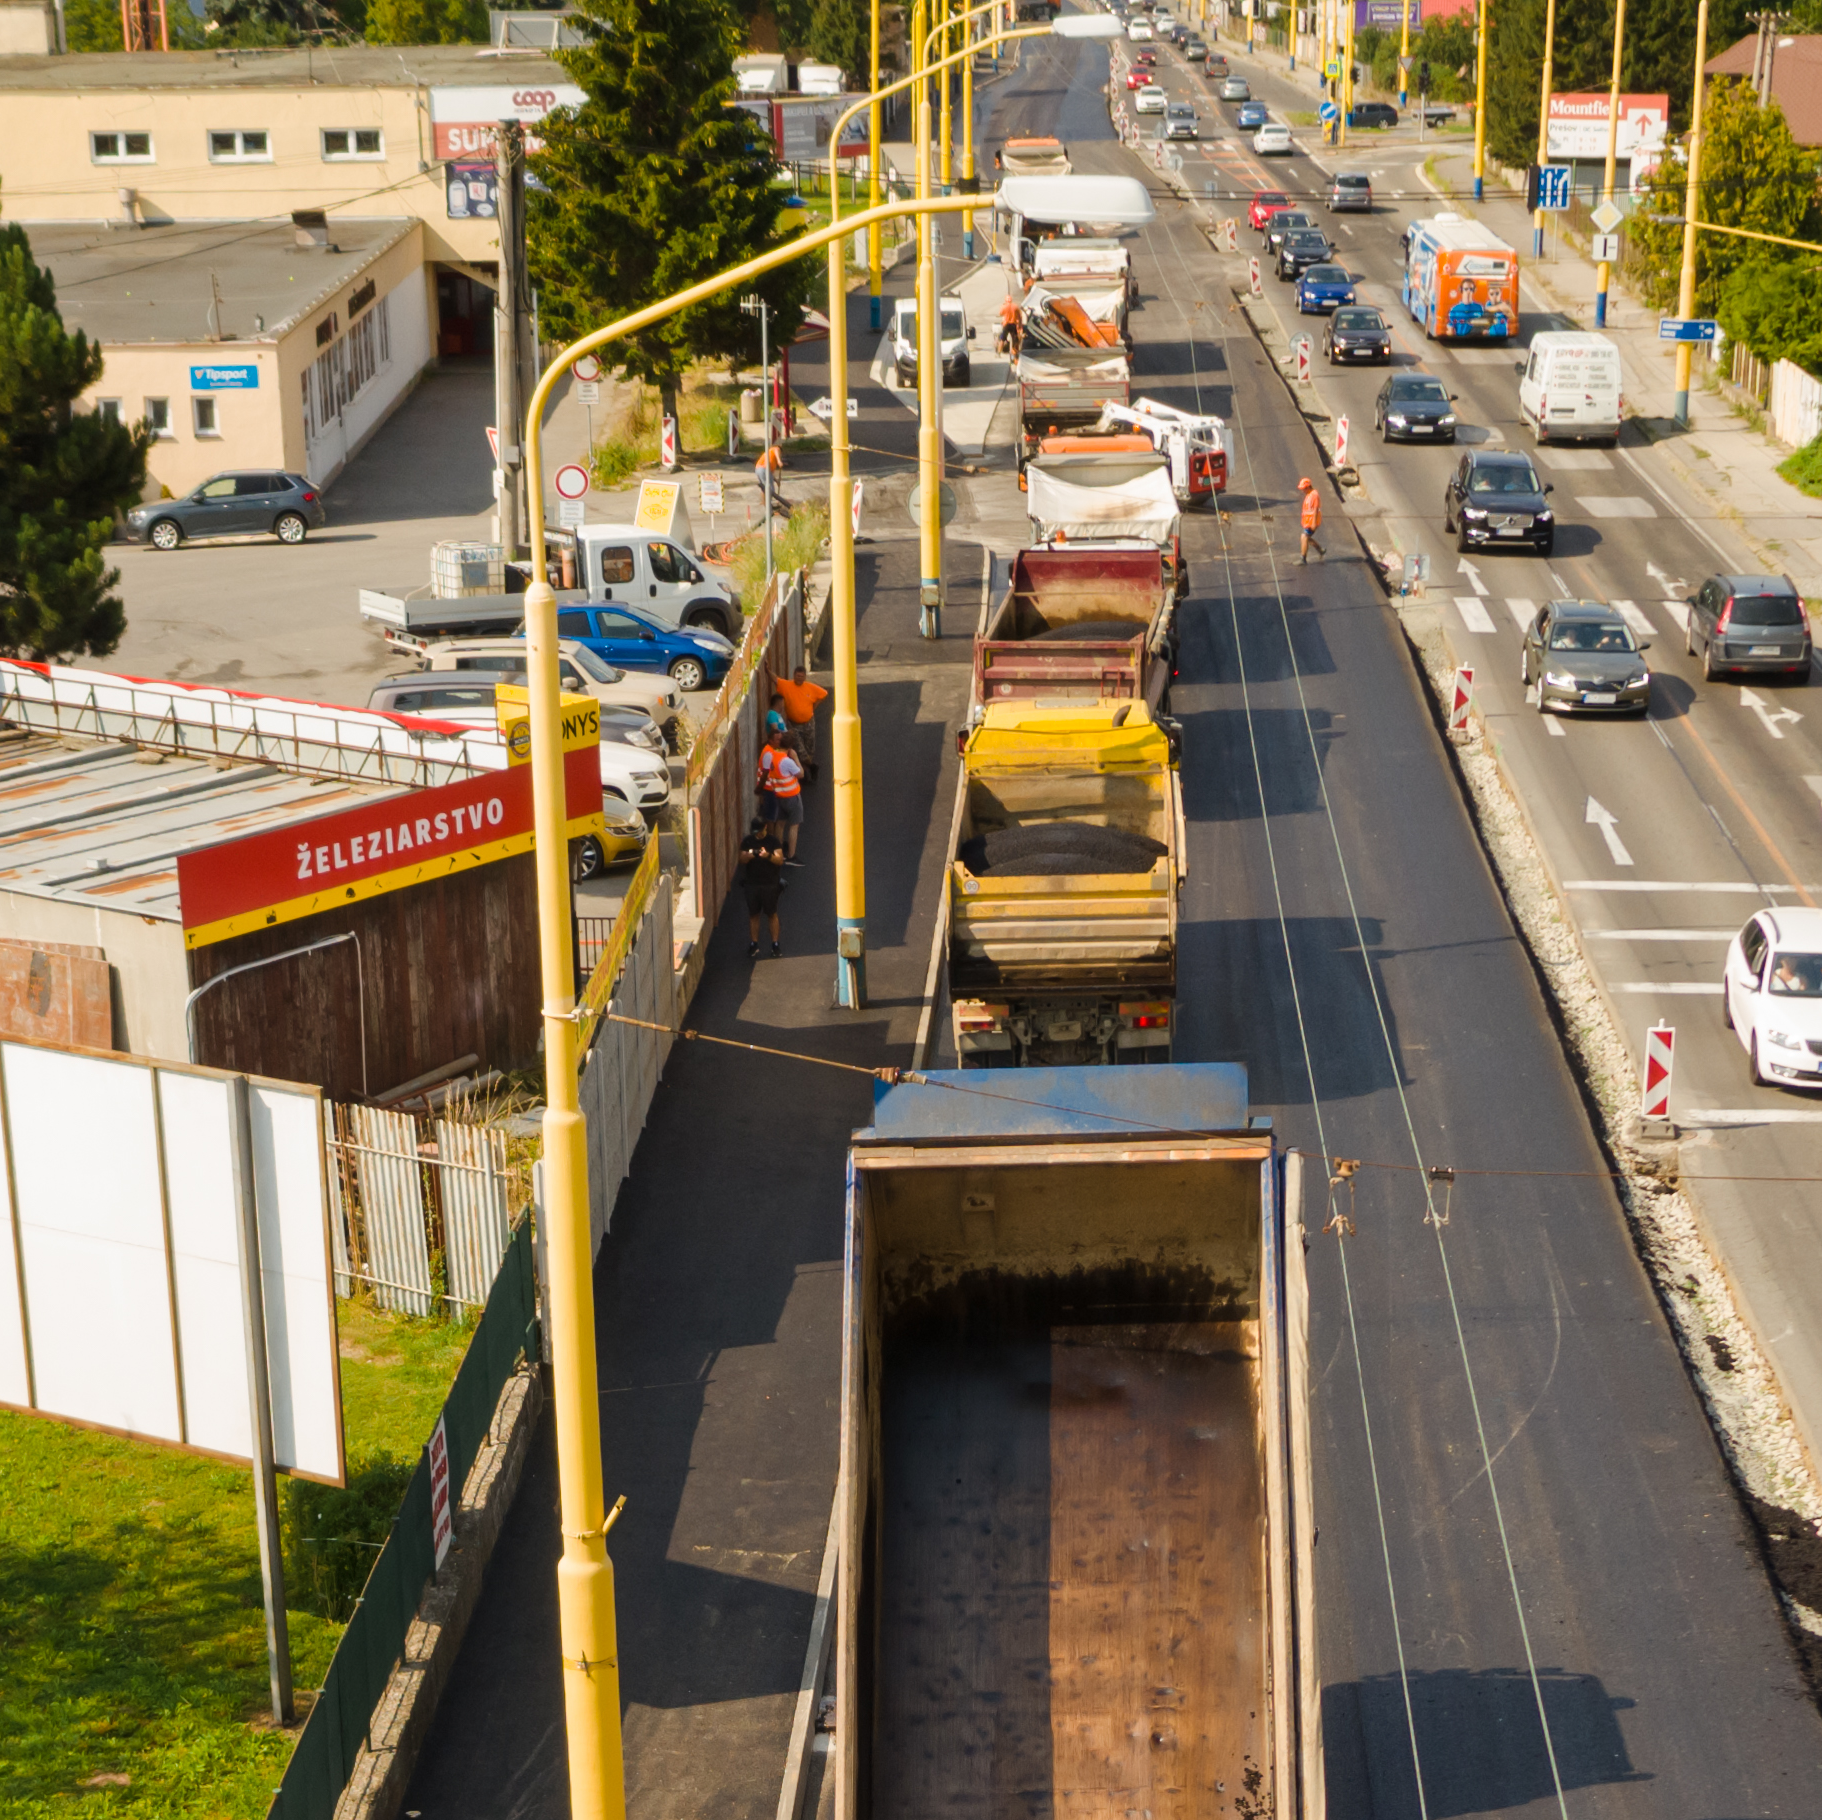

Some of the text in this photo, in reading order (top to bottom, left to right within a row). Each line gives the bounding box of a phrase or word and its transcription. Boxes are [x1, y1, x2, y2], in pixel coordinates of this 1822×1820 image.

[512, 90, 556, 113] coop
[205, 368, 248, 381] Tipsport
[296, 797, 504, 880] ŽELEZIARSTVO
